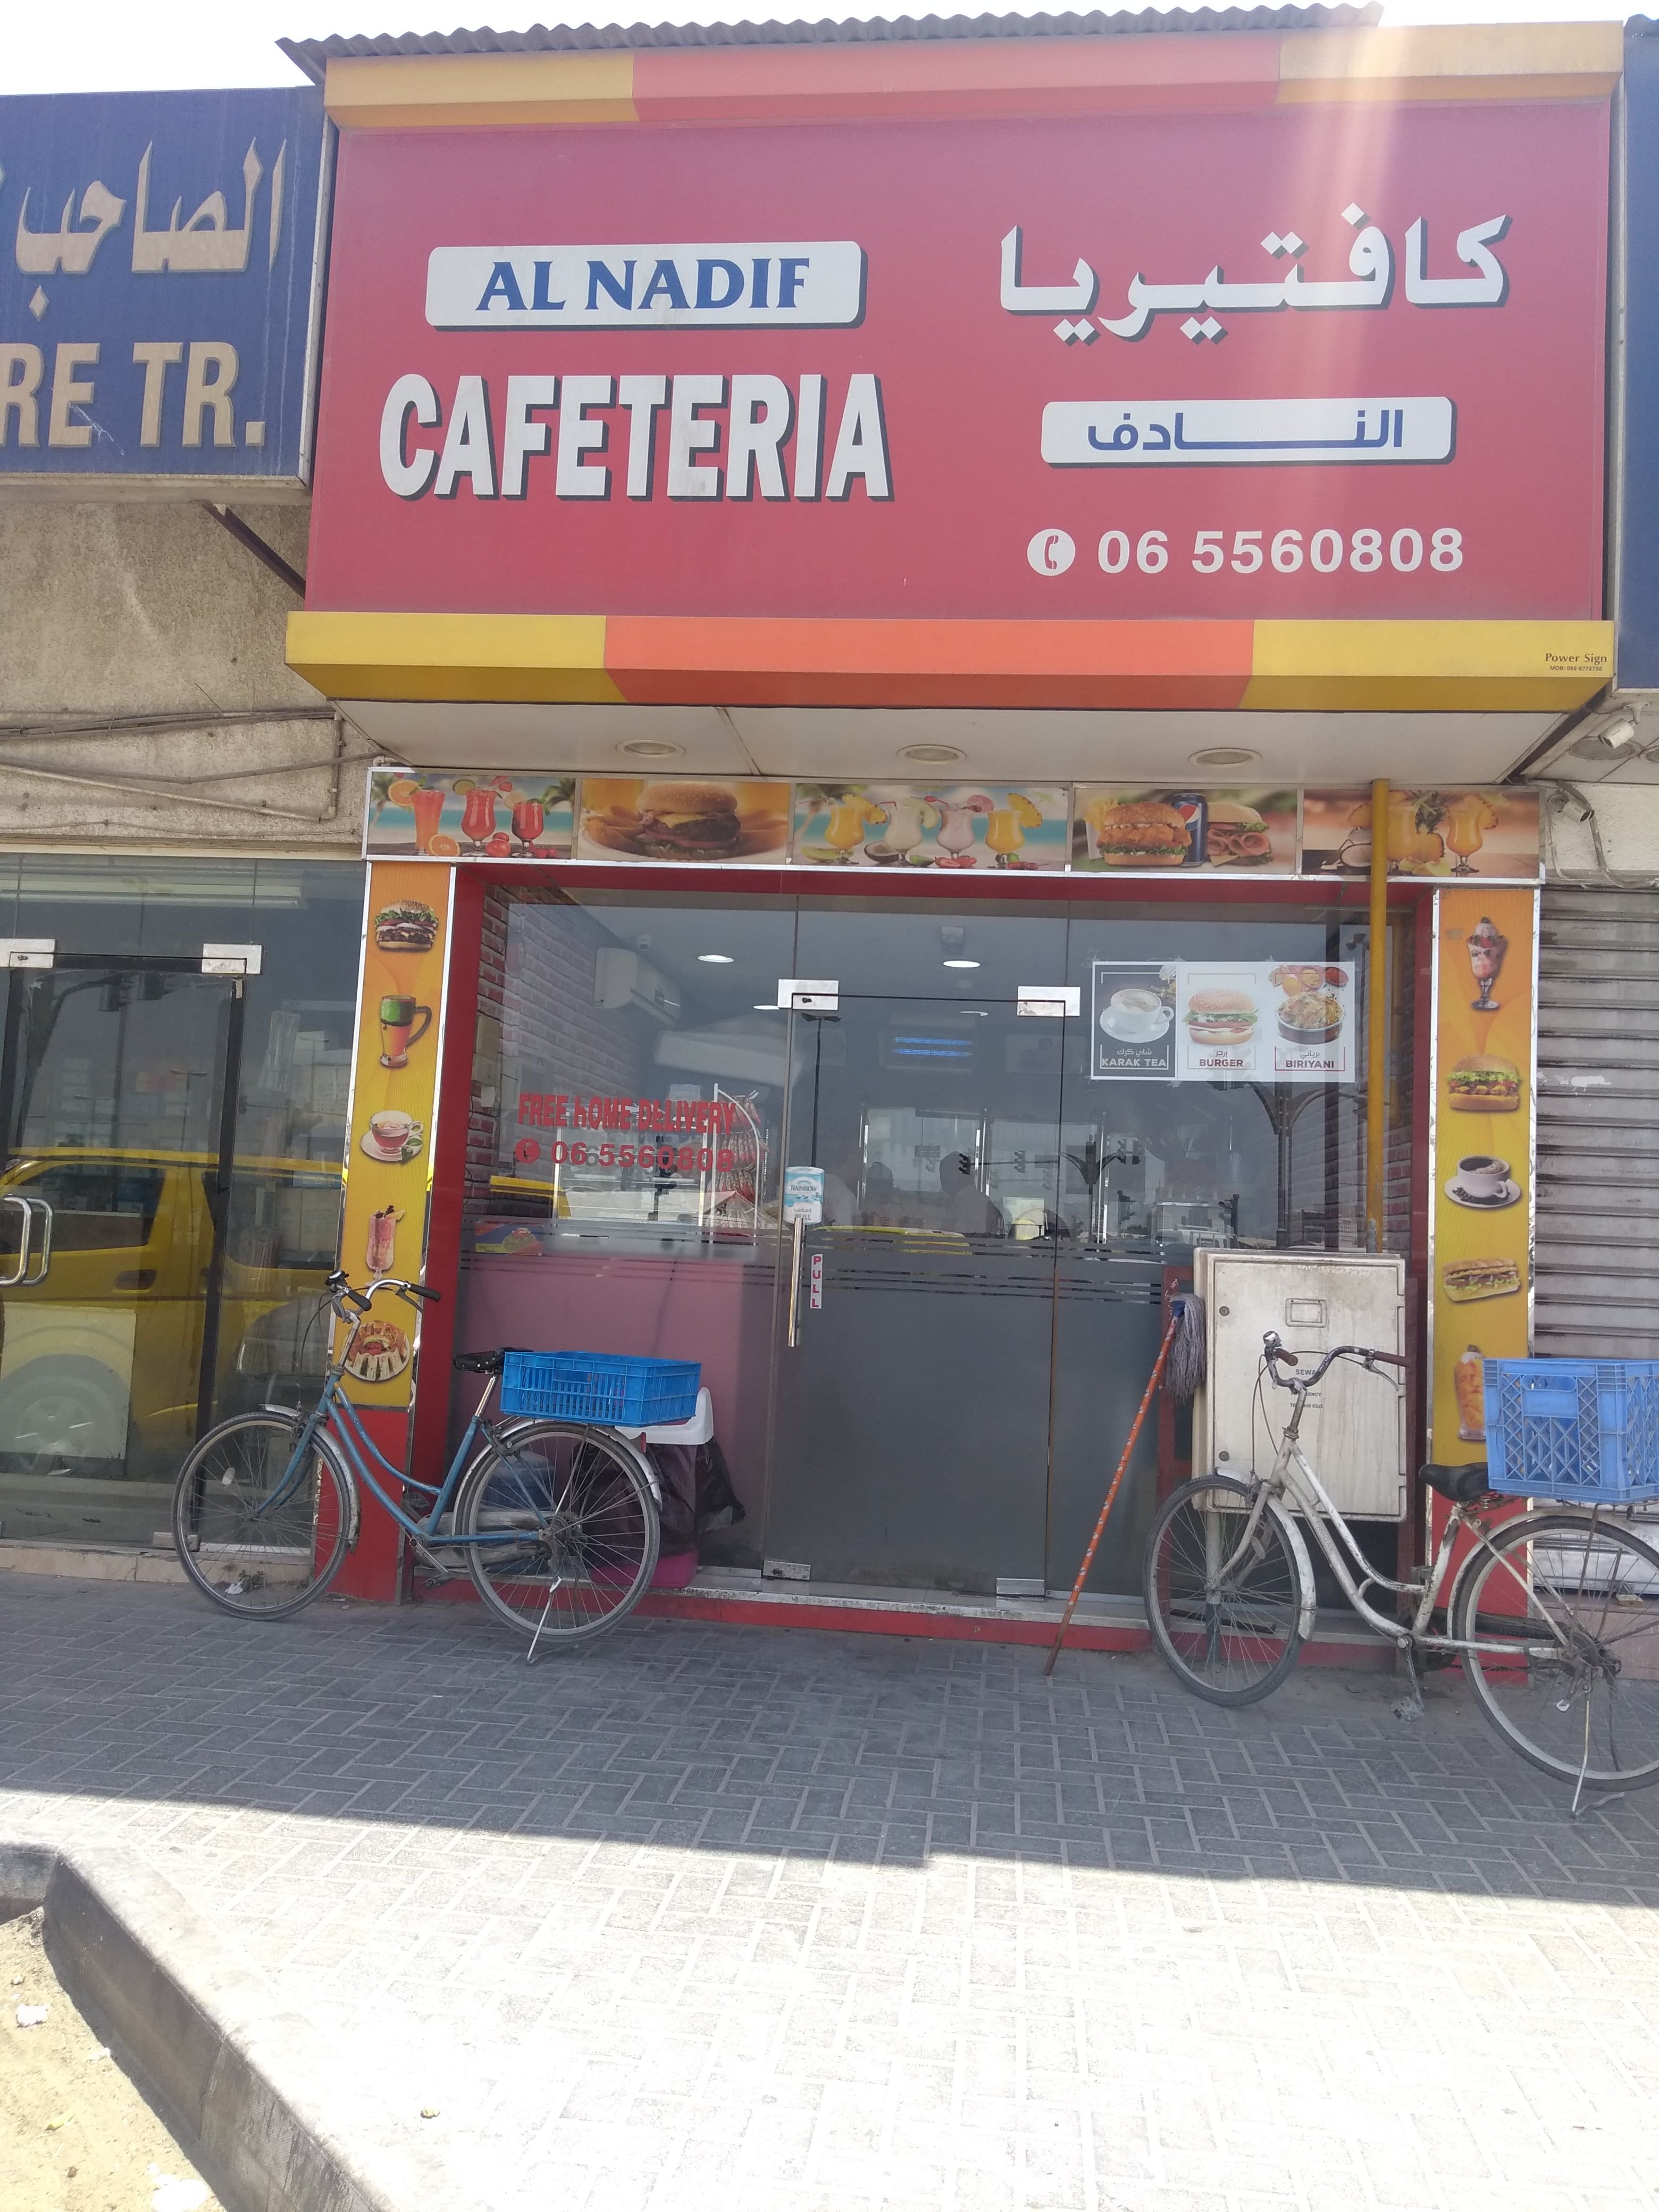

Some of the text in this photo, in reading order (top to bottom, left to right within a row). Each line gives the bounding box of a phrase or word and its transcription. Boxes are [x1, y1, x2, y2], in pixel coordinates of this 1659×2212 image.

[475, 257, 810, 311] AL NADIF
[1000, 202, 1511, 345] كافتيريا
[132, 341, 265, 448] TR.
[380, 373, 892, 500] CAFETERIA
[1098, 529, 1464, 573] 06 5560808
[1545, 653, 1607, 665] Power Sign
[1102, 1058, 1166, 1067] KARAK TEA
[1117, 1048, 1134, 1057] كرك
[1285, 1060, 1335, 1068] BIRIYANI
[518, 1093, 568, 1127] FREE
[638, 1097, 736, 1135] DELIVERY
[550, 1141, 734, 1172] 06 5560808
[812, 1255, 822, 1308] PULL
